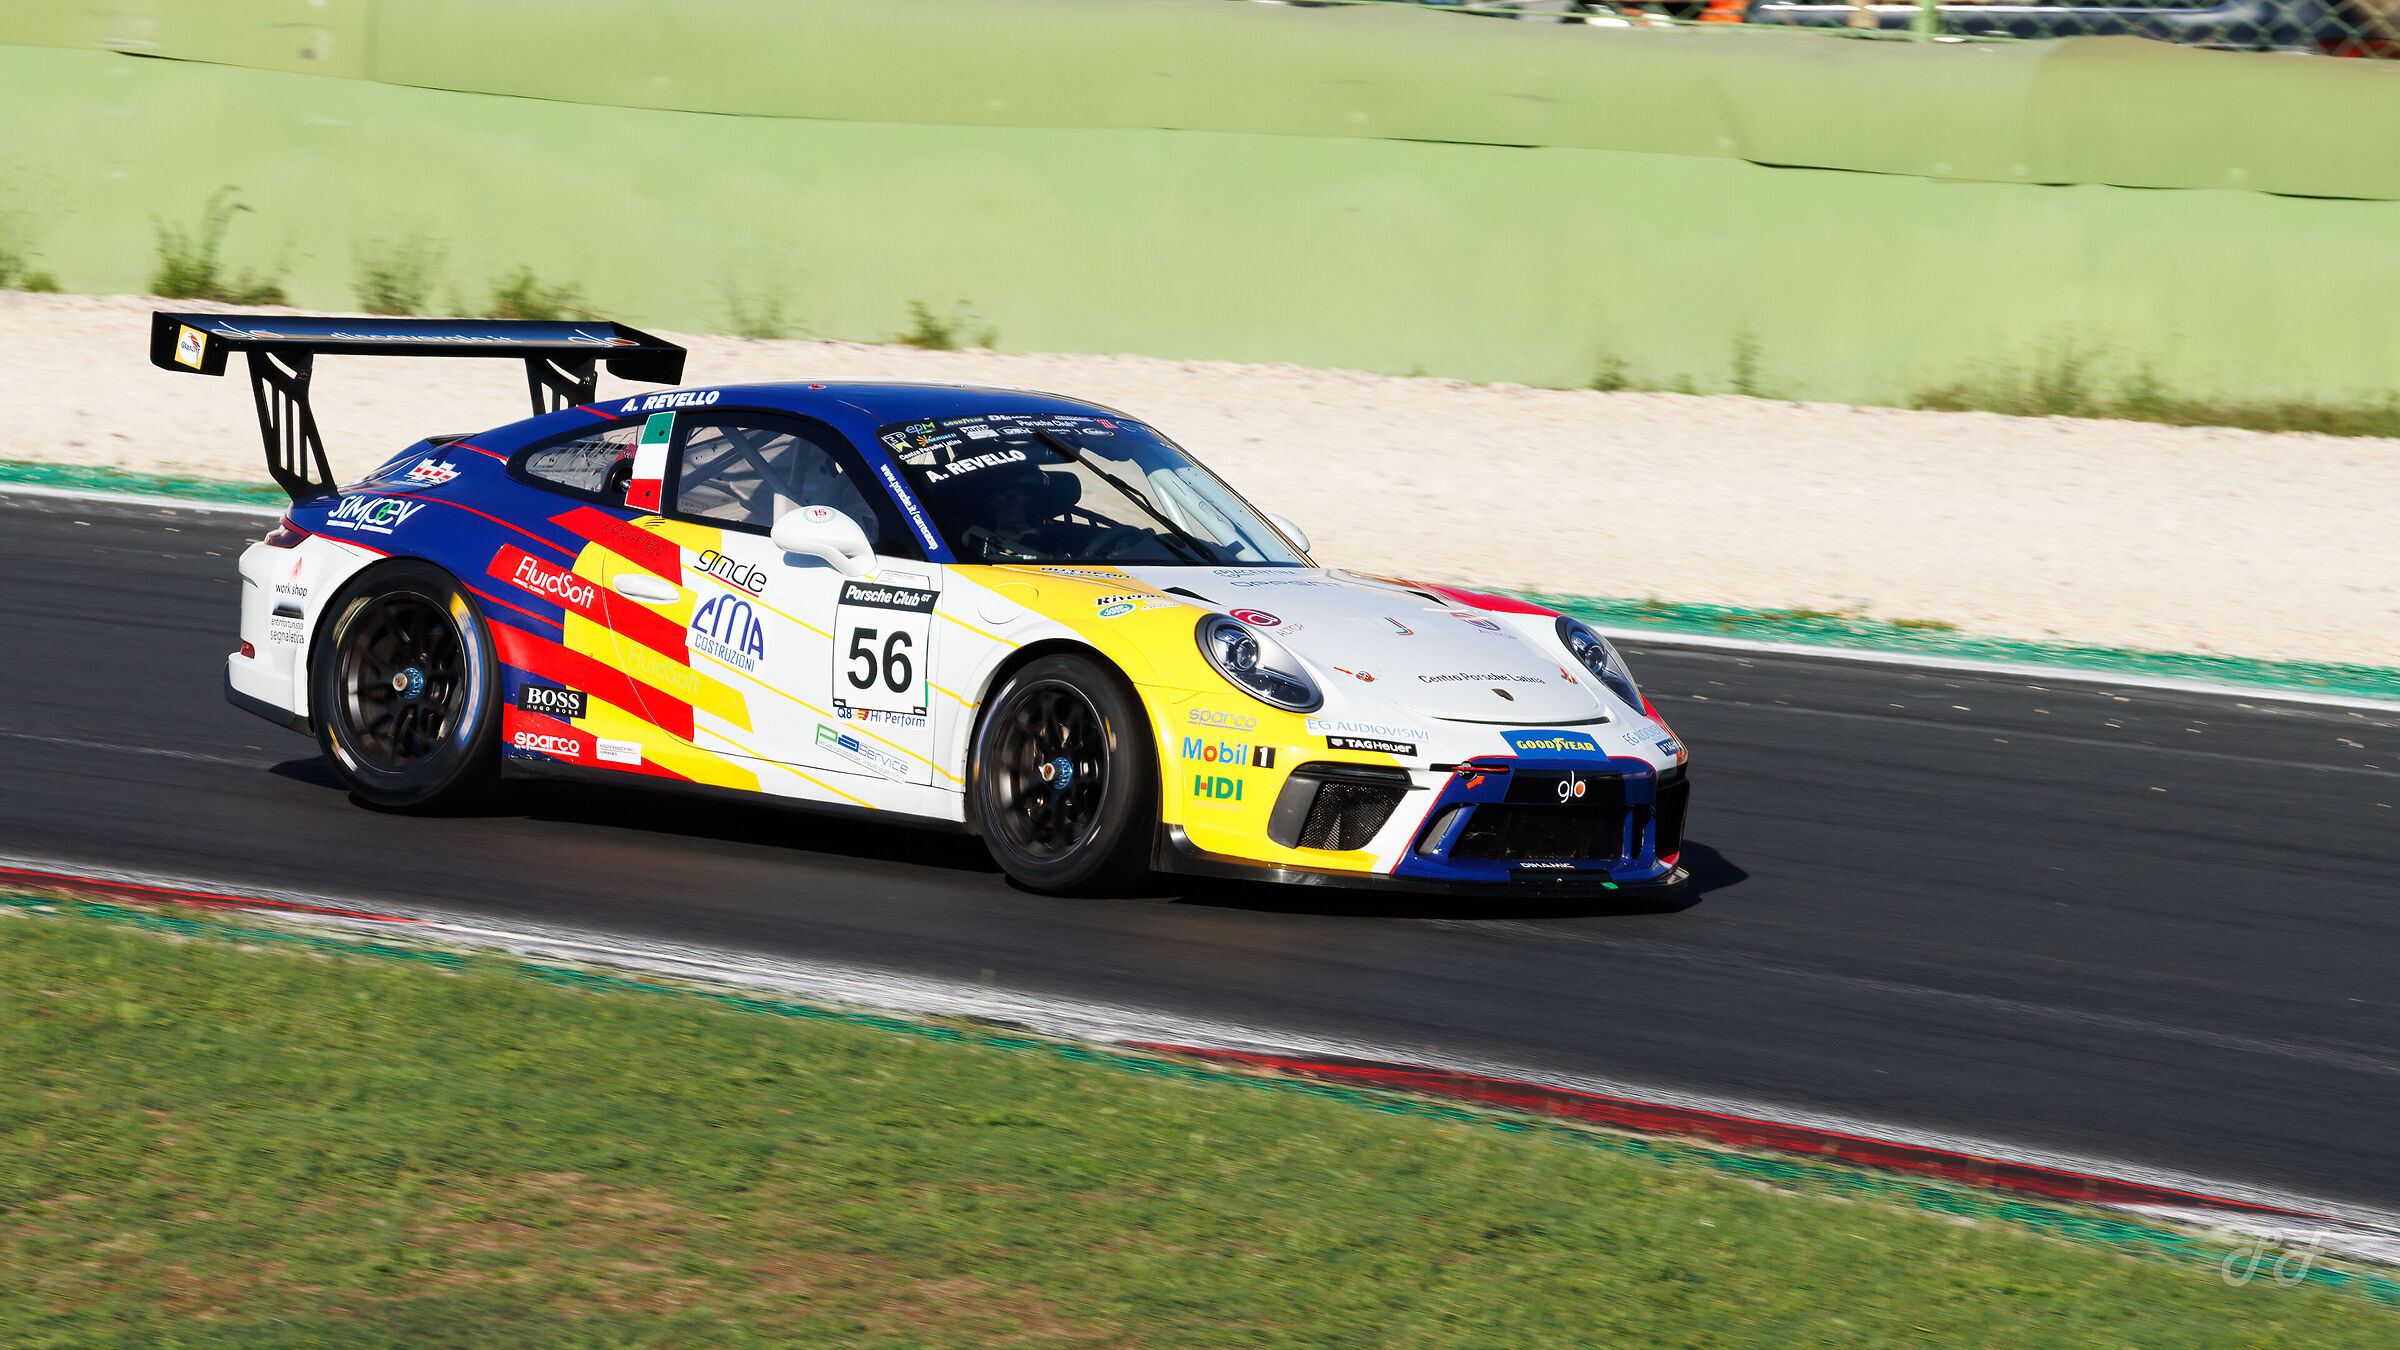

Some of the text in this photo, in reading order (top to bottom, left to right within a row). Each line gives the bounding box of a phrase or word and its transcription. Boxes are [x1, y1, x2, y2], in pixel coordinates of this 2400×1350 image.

[620, 391, 720, 412] A. REVELLO
[925, 449, 1027, 484] A. REVELLO
[276, 582, 308, 599] work shop
[515, 555, 595, 609] FluidSoft
[845, 585, 933, 607] Porsche Club GT
[695, 634, 755, 673] COSTRUZIONI
[847, 626, 913, 694] 56
[1418, 674, 1463, 683] Centro
[1460, 672, 1510, 681] Porsche
[526, 704, 579, 715] HUGO BOSS
[527, 687, 580, 710] BOSS
[837, 706, 926, 728] Q8 Hi Perform
[1189, 707, 1257, 728] sparco
[514, 731, 580, 751] sparco
[1307, 718, 1430, 742] EG AUDIOVISIVI
[1182, 736, 1269, 768] Mobil 1
[1516, 737, 1596, 752] GOODYEAR
[1194, 774, 1243, 801] HDI
[1557, 770, 1587, 804] glo
